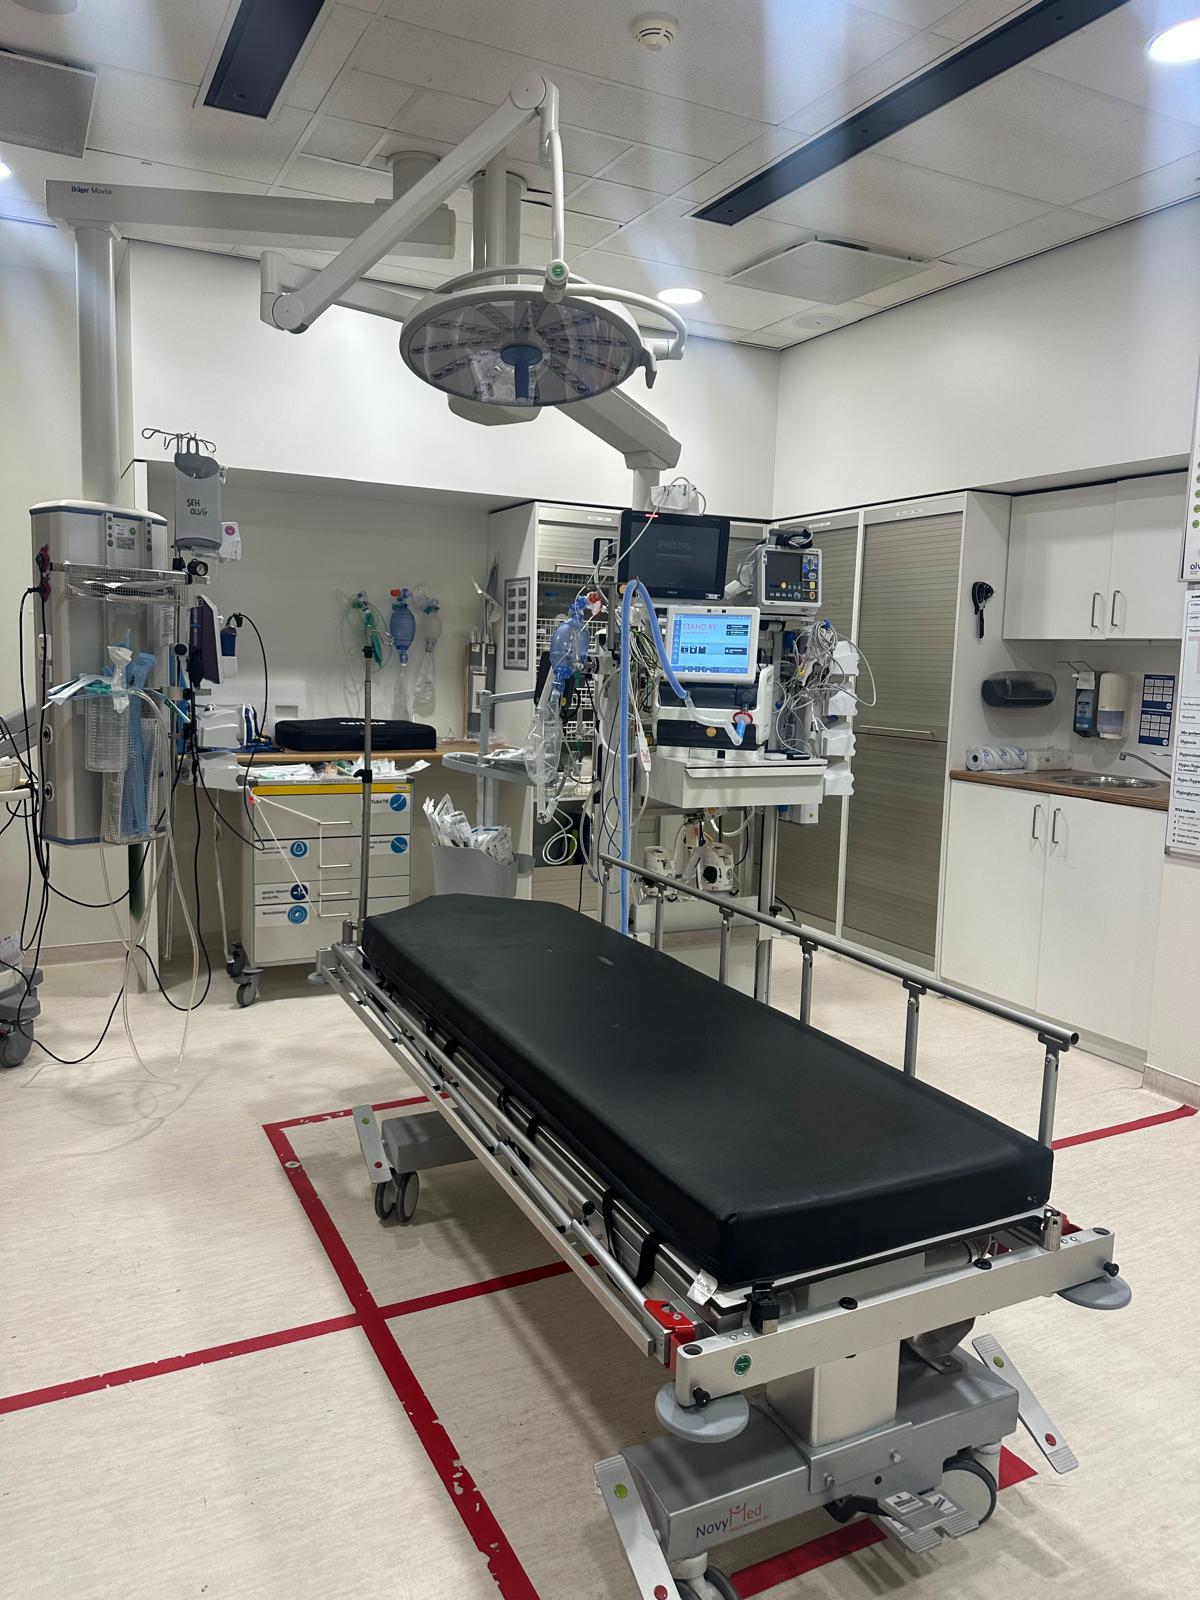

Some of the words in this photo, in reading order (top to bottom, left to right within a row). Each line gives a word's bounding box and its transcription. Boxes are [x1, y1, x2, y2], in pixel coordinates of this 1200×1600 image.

[91, 186, 112, 194] Movita
[186, 498, 200, 507] SEH
[658, 540, 693, 551] PHILIPS
